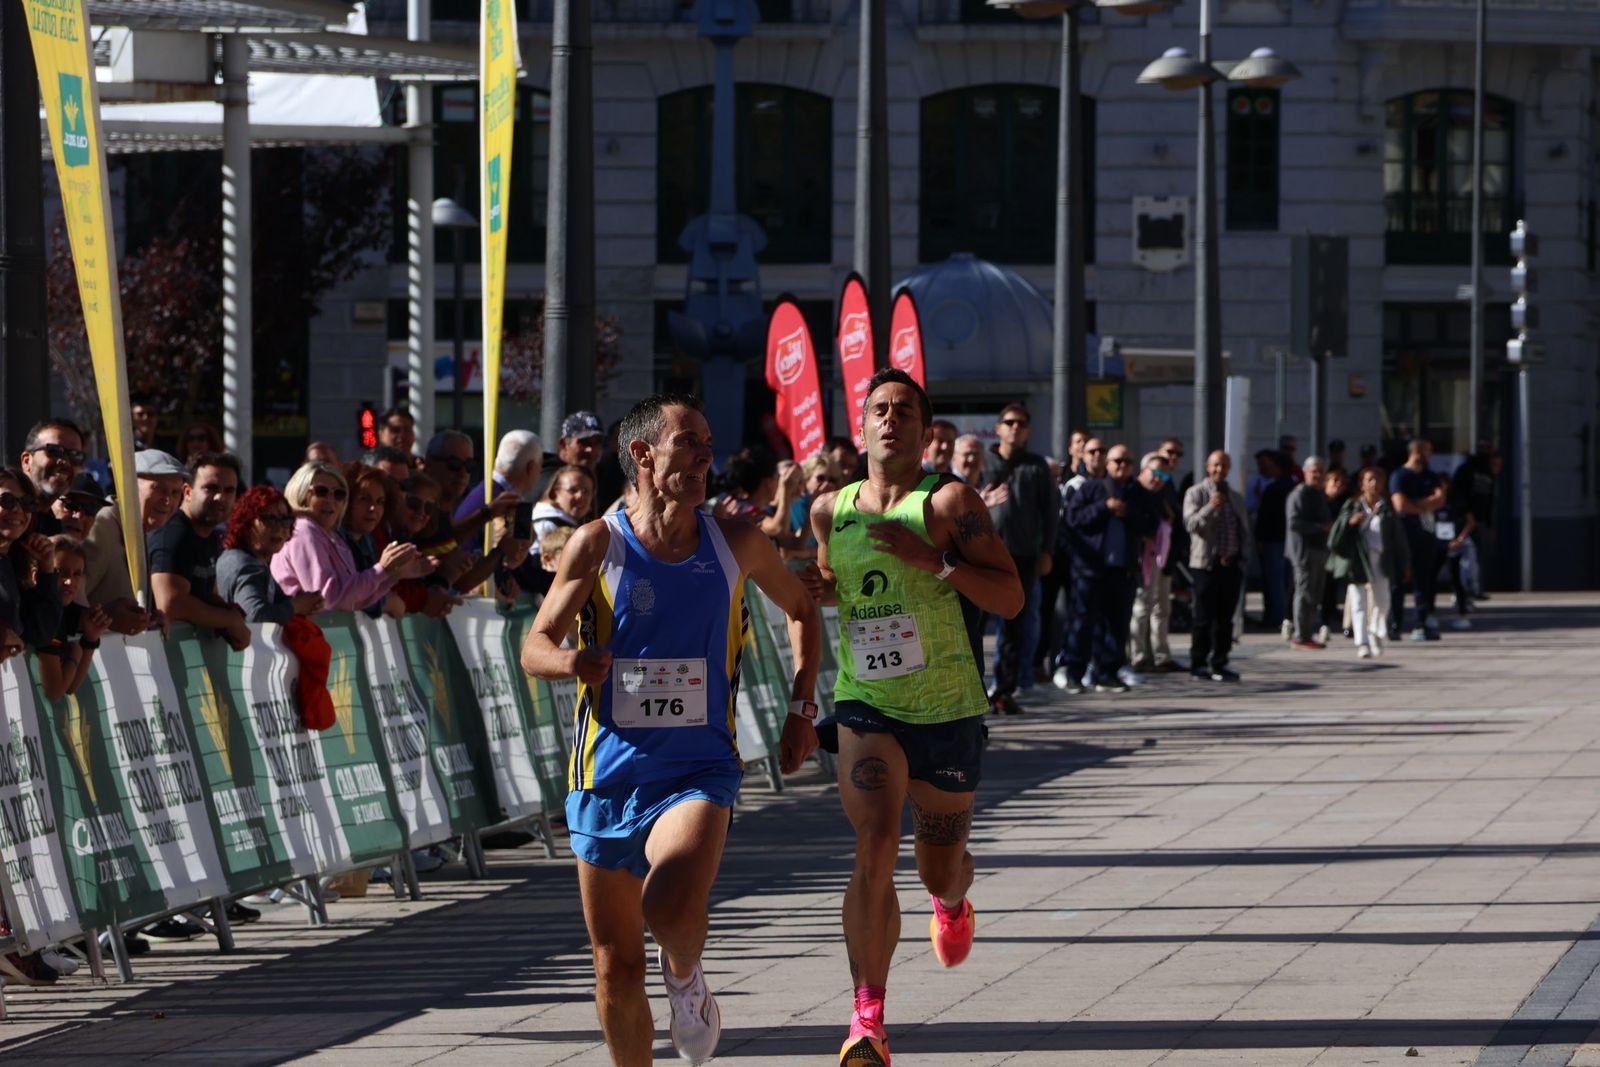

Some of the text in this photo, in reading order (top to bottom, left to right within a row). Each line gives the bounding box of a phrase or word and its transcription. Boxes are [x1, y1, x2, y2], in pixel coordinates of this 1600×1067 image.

[850, 603, 903, 619] Adarsa
[866, 651, 902, 670] 213
[640, 698, 684, 716] 176
[127, 759, 204, 816] CAJA RURAL
